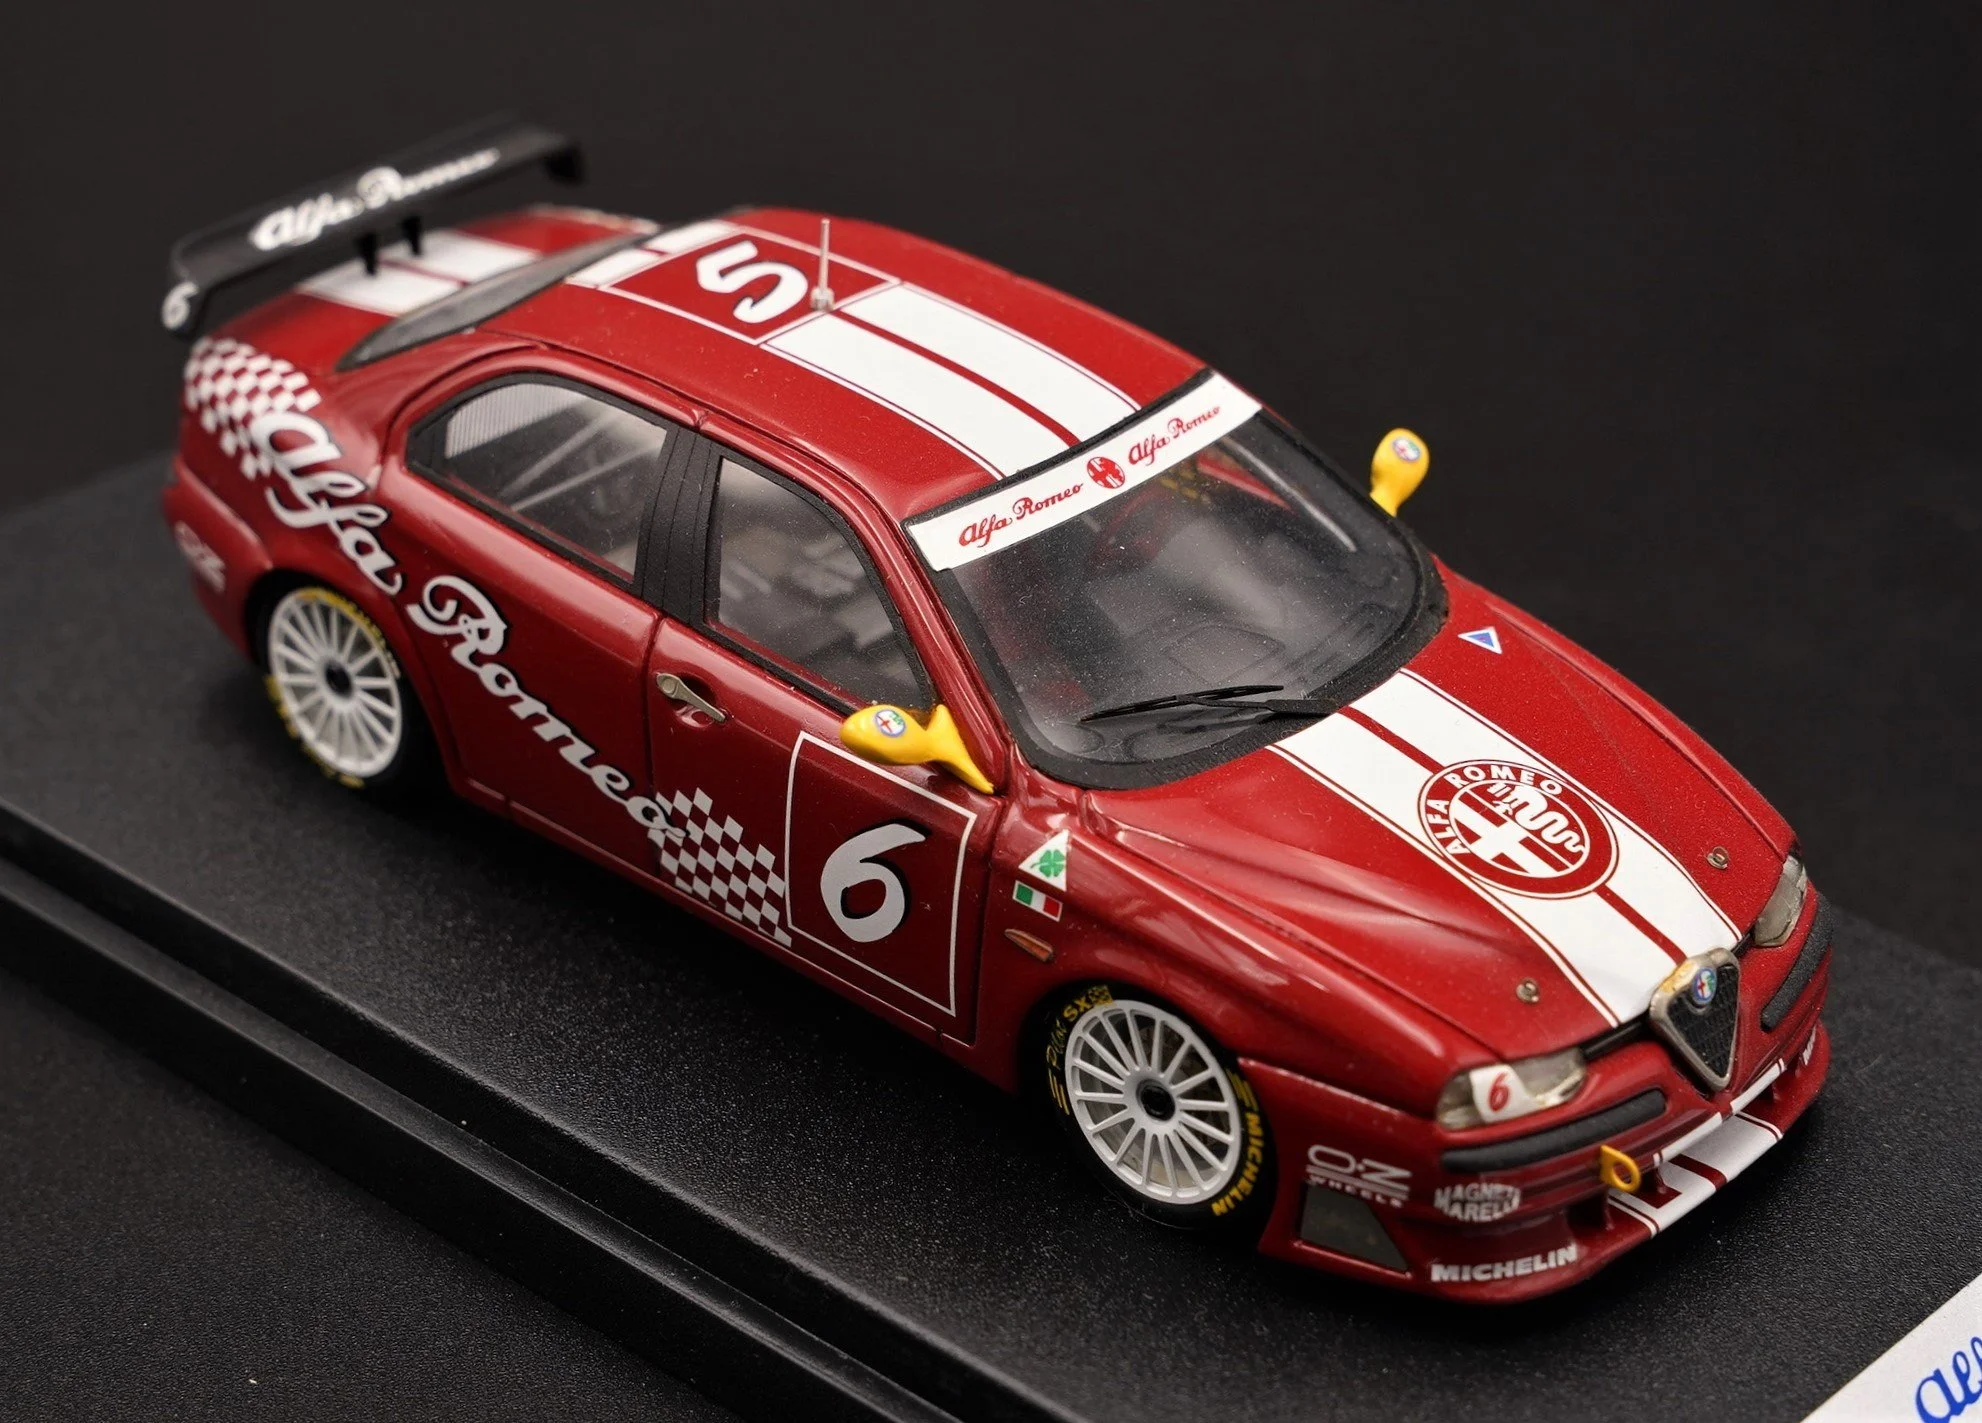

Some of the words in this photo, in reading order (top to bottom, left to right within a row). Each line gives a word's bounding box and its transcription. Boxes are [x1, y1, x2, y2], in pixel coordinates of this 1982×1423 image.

[162, 282, 199, 329] 6
[1128, 434, 1171, 467] Alfa
[1167, 406, 1221, 439] Romeo
[958, 514, 1013, 548] Alfa
[1012, 483, 1083, 520] Romeo
[250, 411, 403, 596] Alfa
[405, 575, 688, 838] Romeo
[1444, 765, 1562, 795] ROMEO
[1426, 799, 1472, 855] ALFA
[820, 823, 926, 943] 6
[1488, 1072, 1510, 1112] 6
[1212, 1112, 1264, 1217] MICHELIN
[1431, 1242, 1578, 1282] MICHELIN
